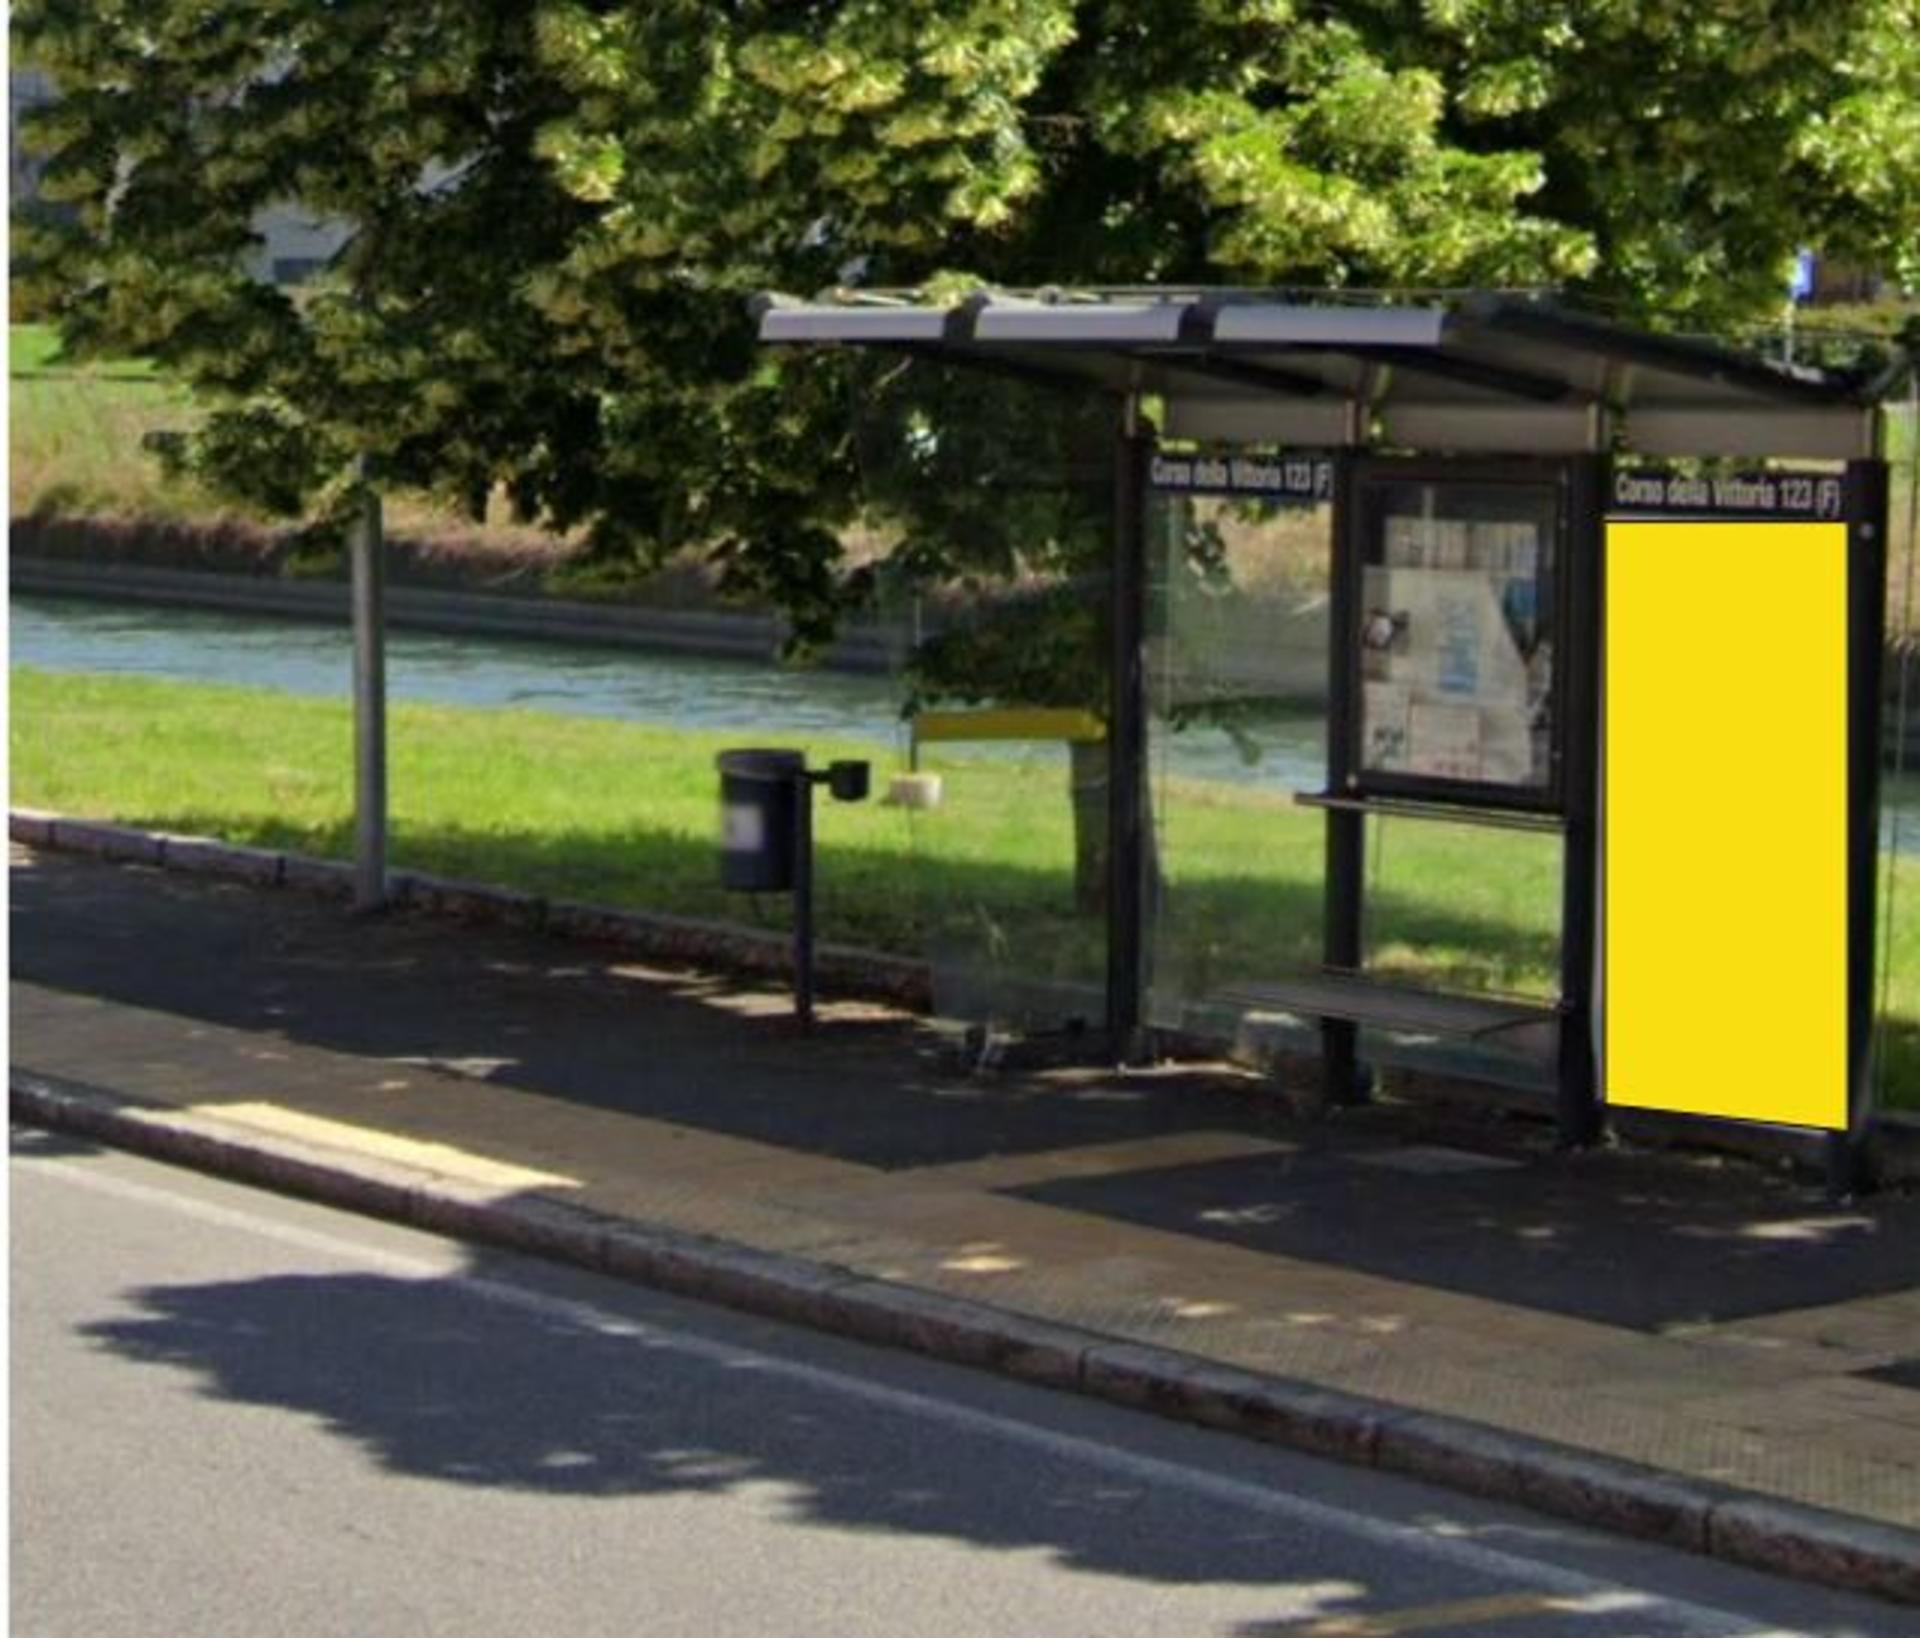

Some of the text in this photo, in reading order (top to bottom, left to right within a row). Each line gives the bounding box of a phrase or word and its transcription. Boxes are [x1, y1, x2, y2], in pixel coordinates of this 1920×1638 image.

[1615, 473, 1841, 517] Corso della Vittoria 123 (F)
